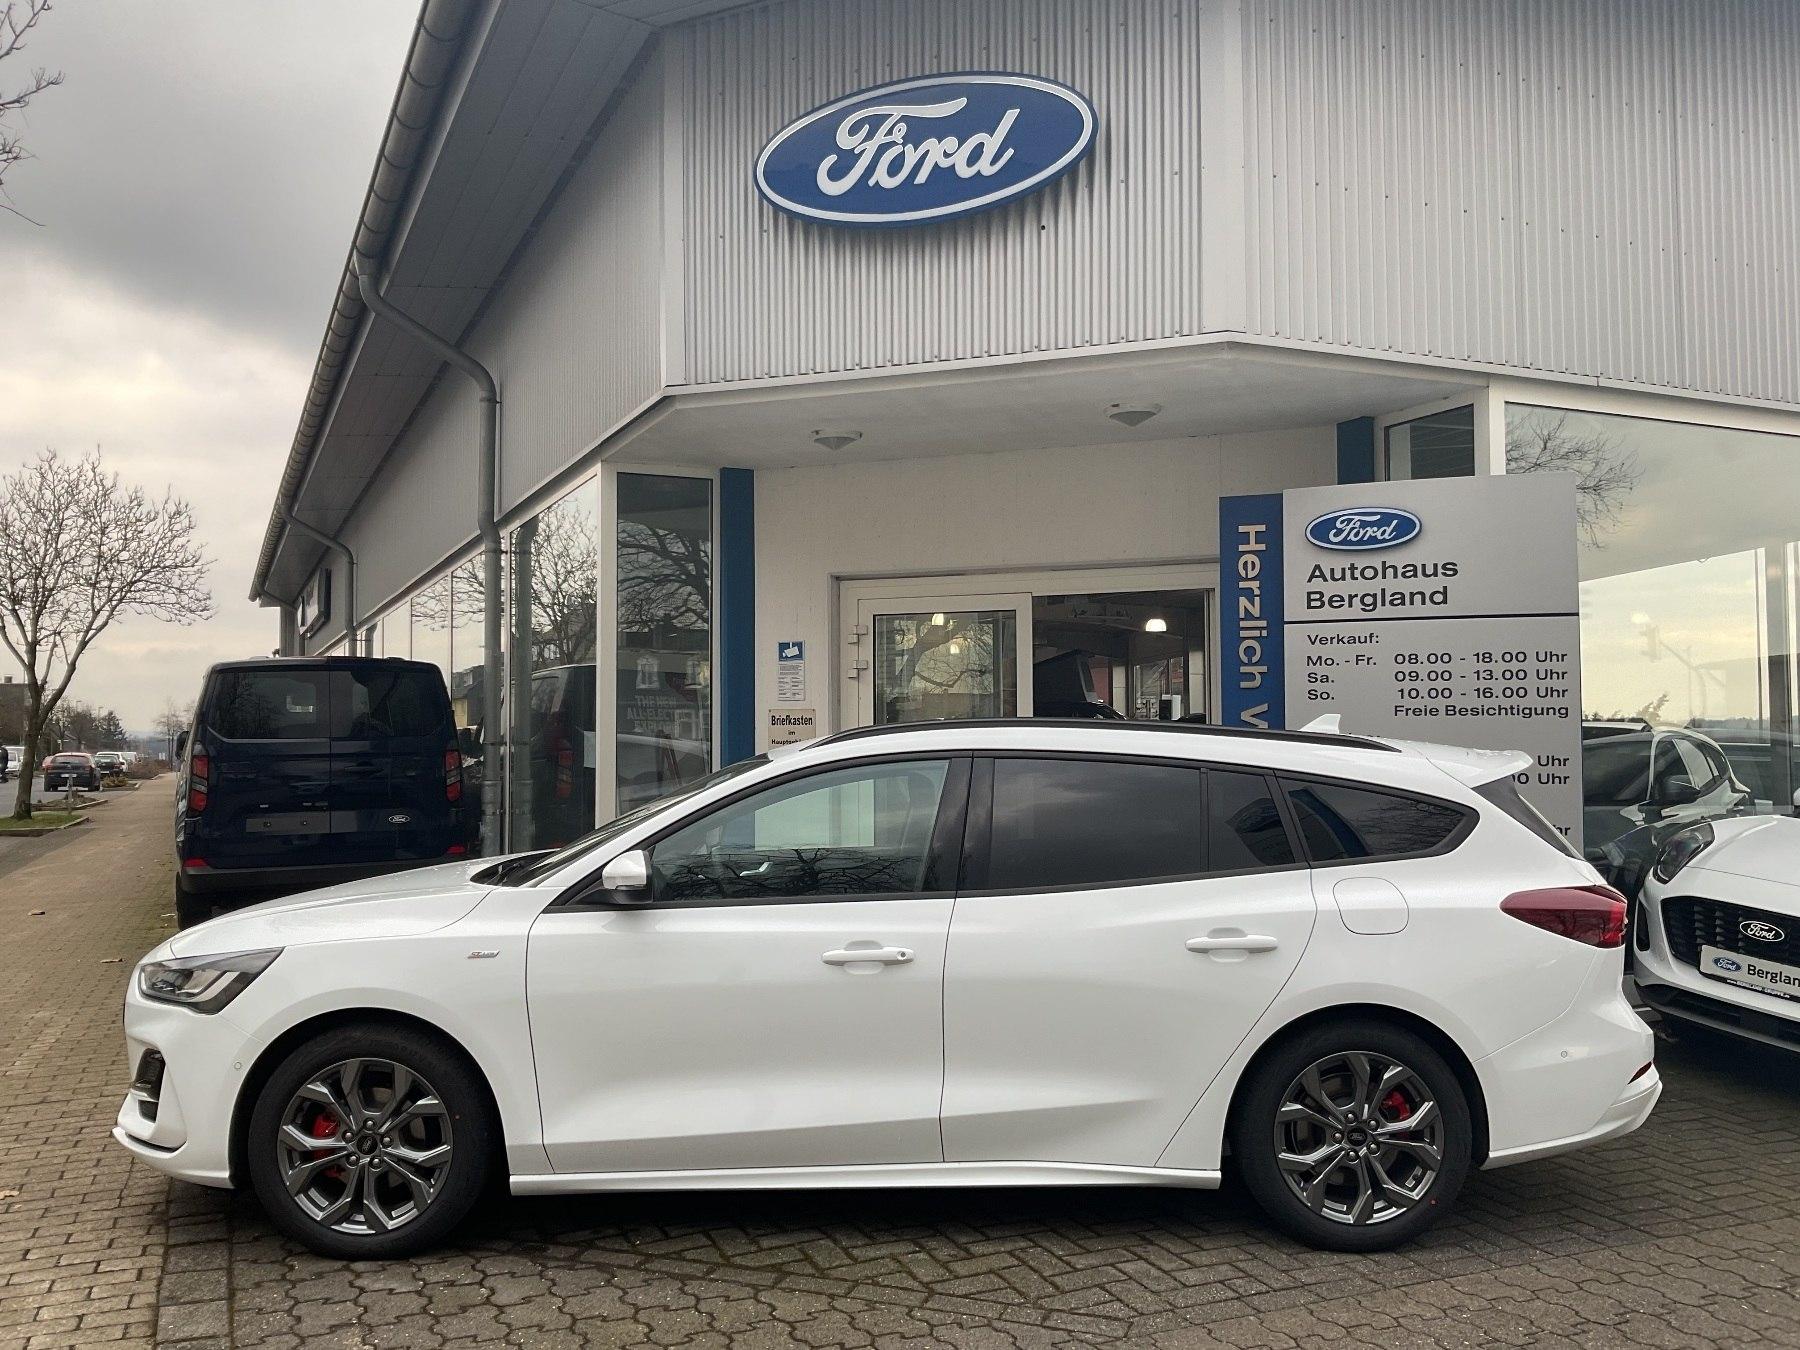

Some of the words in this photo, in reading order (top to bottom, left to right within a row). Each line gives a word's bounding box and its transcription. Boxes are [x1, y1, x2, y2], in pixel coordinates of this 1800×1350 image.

[816, 97, 1021, 196] Ford
[1328, 514, 1399, 543] Ford
[1306, 560, 1459, 584] Autohaus
[1237, 523, 1268, 690] Herzlich
[1306, 585, 1448, 613] Bergland
[1306, 632, 1380, 646] Verkauf:
[1306, 655, 1340, 667] Mo.
[1355, 653, 1377, 666] Fr.
[1393, 652, 1453, 665] 08.00
[1472, 650, 1528, 664] 18.00
[1535, 650, 1568, 663] Uhr
[1307, 671, 1335, 684] Sa.
[1394, 669, 1453, 683] 09.00
[1472, 668, 1528, 682] 13.00
[1535, 668, 1569, 681] Uhr
[1307, 688, 1335, 701] So.
[1397, 687, 1453, 700] 10.00
[1473, 686, 1528, 699] 16.00
[1536, 686, 1569, 699] Uhr
[1394, 704, 1440, 717] Freie
[1444, 702, 1570, 719] Besichtigung
[771, 714, 813, 726] Briefkasten
[1537, 754, 1570, 767] Uhr
[1537, 772, 1571, 785] Uhr
[1552, 824, 1572, 836] hr
[1747, 922, 1776, 940] Ford
[1717, 958, 1737, 971] Ford
